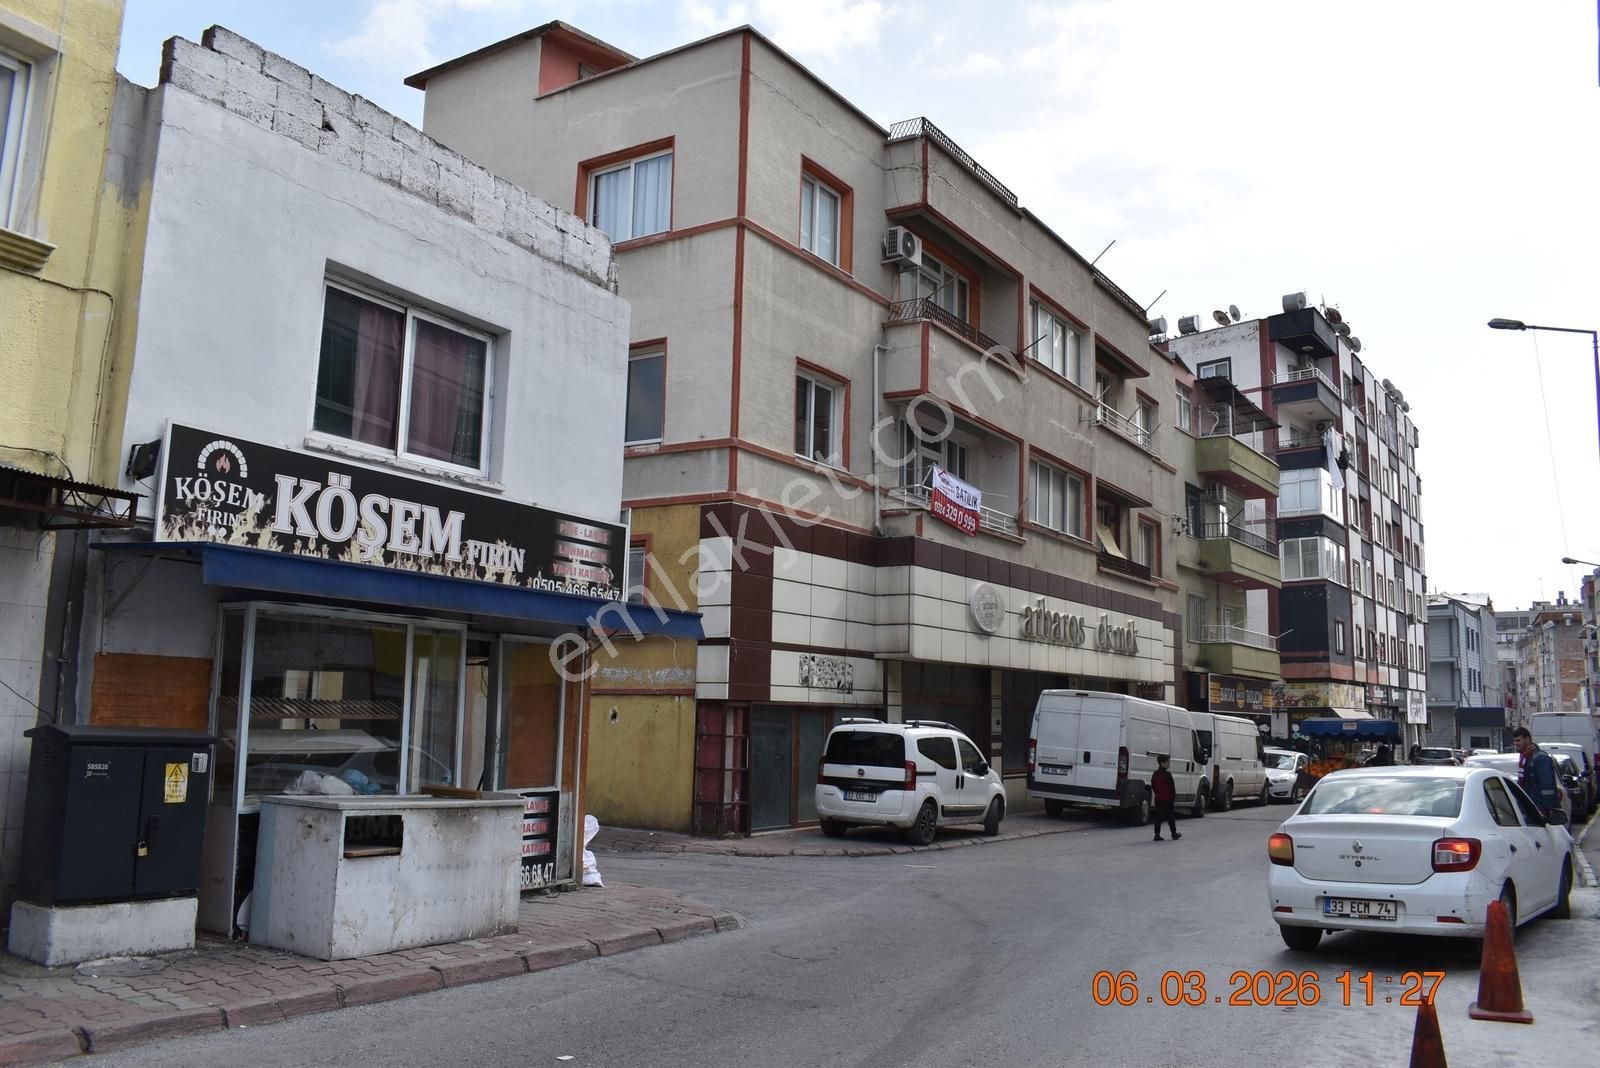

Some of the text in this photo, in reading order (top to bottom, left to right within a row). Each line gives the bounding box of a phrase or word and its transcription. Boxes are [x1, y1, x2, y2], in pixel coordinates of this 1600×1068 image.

[174, 472, 264, 514] KÖŞEM
[955, 486, 978, 509] SATILIK
[271, 471, 465, 562] KÖŞEM
[532, 577, 562, 593] 0505
[565, 582, 587, 597] 466
[543, 862, 554, 882] 47
[1331, 901, 1391, 915] 33 ECM 74
